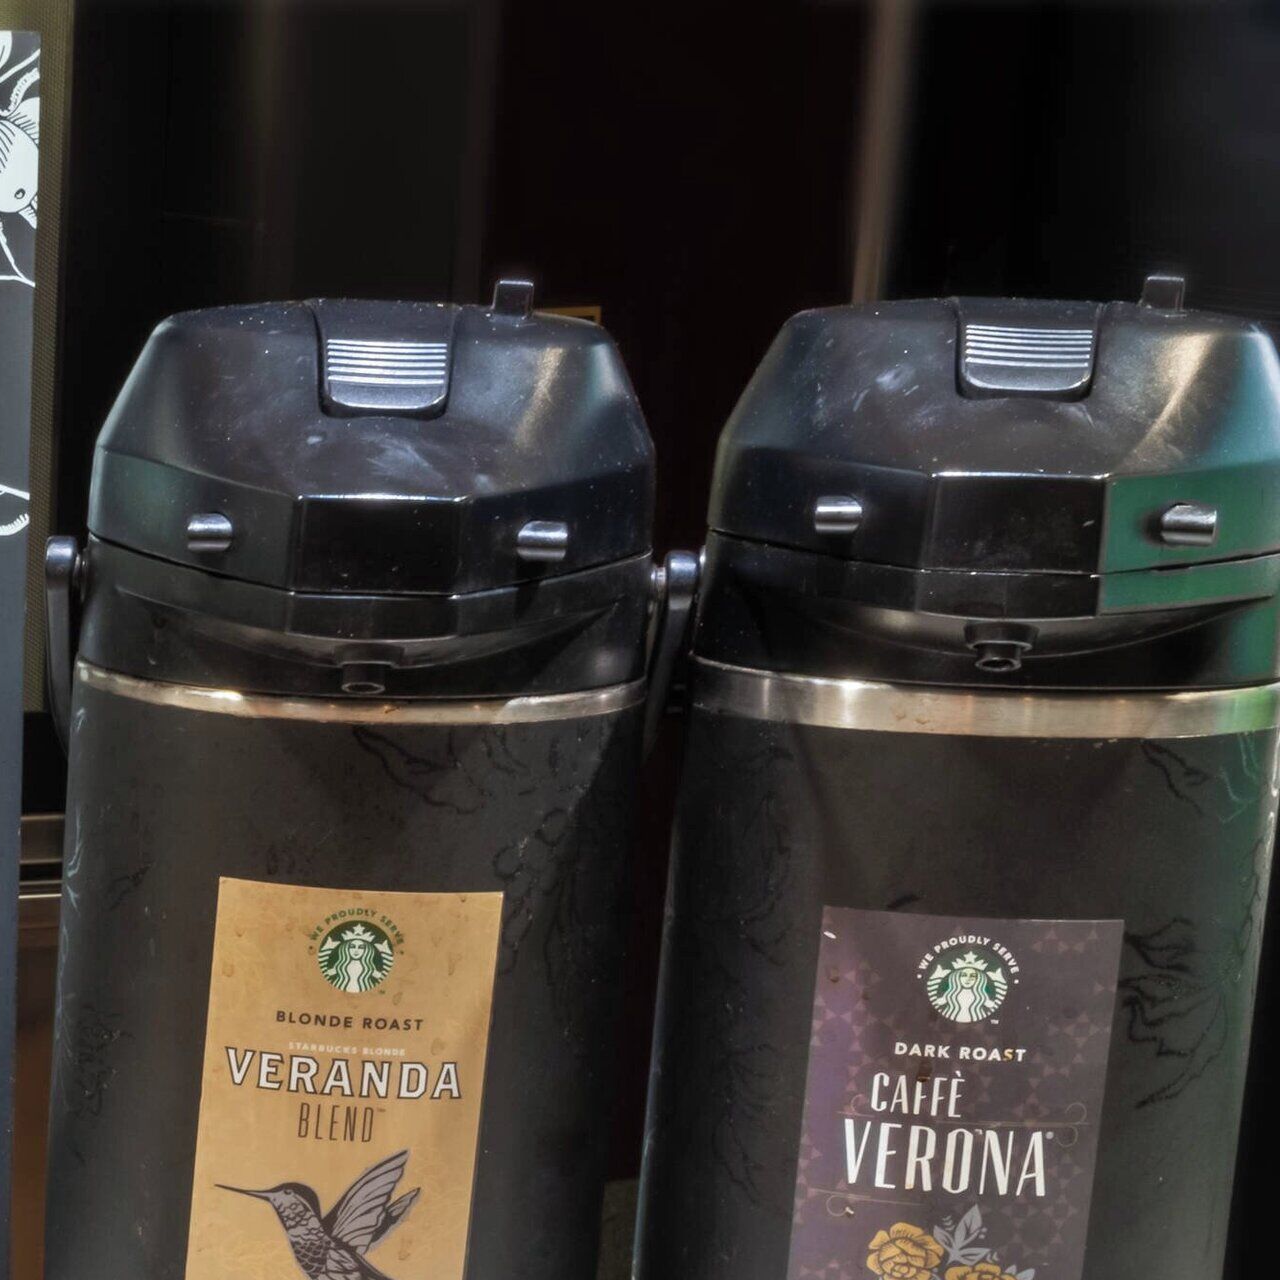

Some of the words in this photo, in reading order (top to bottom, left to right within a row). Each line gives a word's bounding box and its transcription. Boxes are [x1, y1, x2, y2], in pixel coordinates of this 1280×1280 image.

[324, 907, 377, 924] PROUDLY
[918, 953, 934, 970] WE
[934, 935, 991, 954] PROUDLY
[992, 943, 1020, 974] SERVE
[275, 1010, 353, 1028] BLONDE
[362, 1016, 424, 1031] ROAST
[289, 1041, 357, 1055] STARBUCKS
[362, 1046, 406, 1057] BLONDE
[894, 1042, 950, 1059] DARK
[959, 1046, 1027, 1062] ROAST
[225, 1046, 462, 1100] VERANDA
[297, 1102, 375, 1143] BLEND
[844, 1118, 1046, 1197] VERONA
